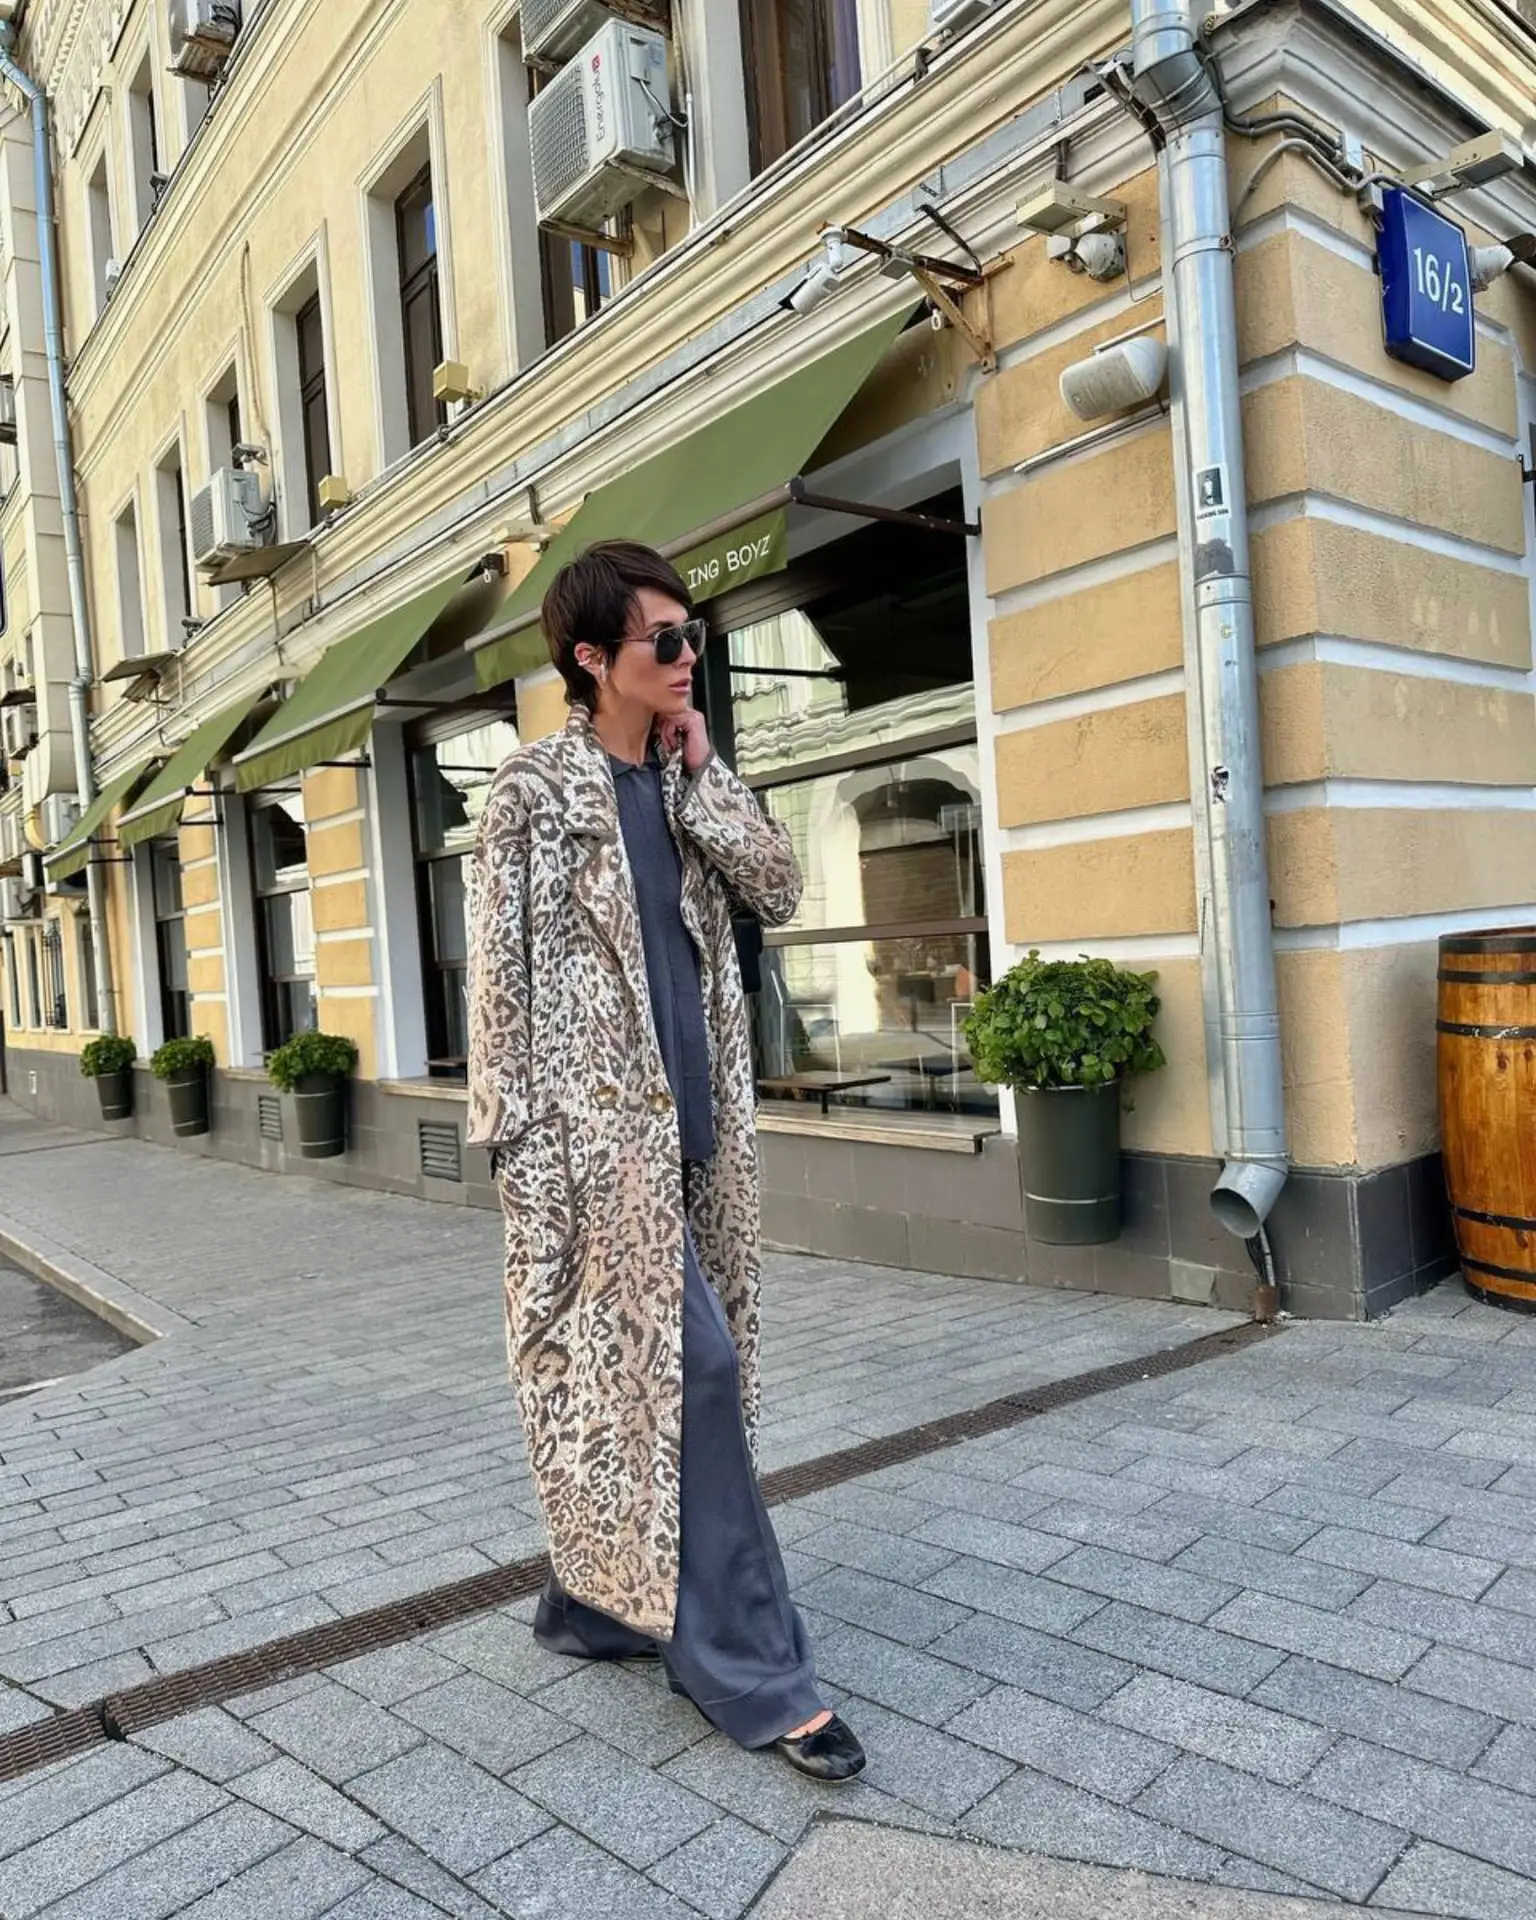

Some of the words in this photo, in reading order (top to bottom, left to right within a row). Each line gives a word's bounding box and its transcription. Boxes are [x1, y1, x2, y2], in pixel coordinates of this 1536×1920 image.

[1412, 247, 1464, 315] 16/2
[680, 559, 719, 590] ING
[726, 534, 770, 572] BOYZ
